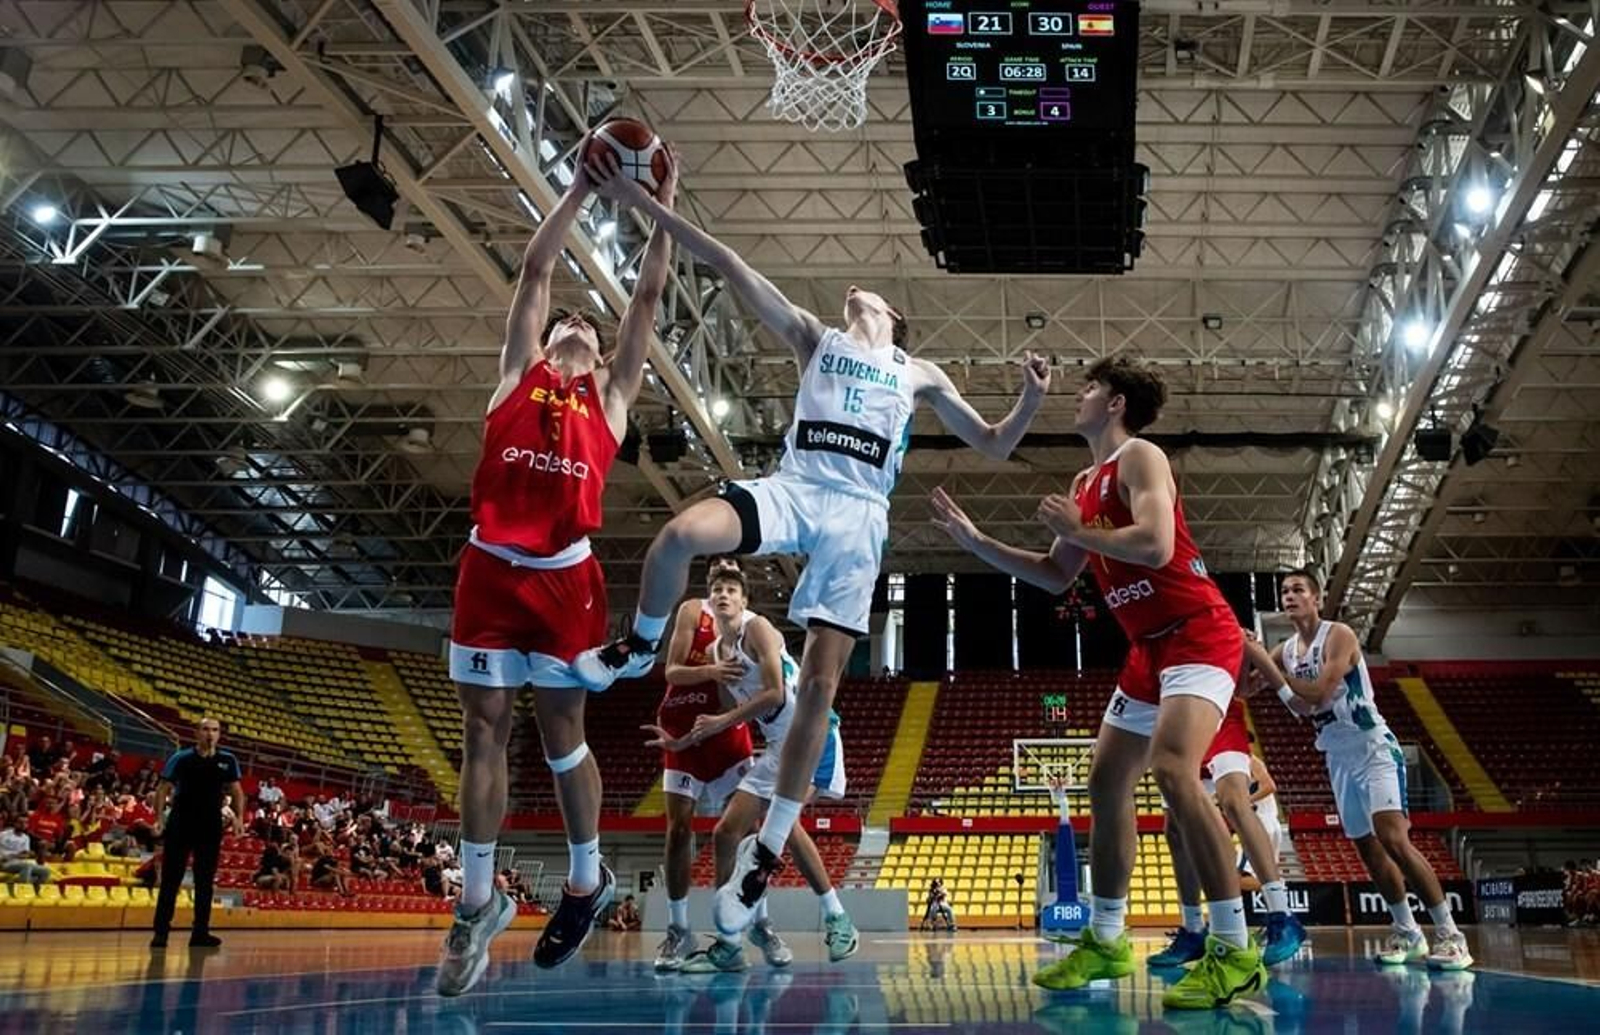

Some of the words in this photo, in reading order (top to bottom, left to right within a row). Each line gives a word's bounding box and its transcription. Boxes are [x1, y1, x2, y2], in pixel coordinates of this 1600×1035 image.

[925, 1, 951, 9] HOME
[978, 15, 1001, 32] 21
[1037, 16, 1063, 32] 30
[952, 66, 972, 78] 2Q
[1003, 66, 1043, 78] 06:28
[1072, 67, 1089, 79] 14
[986, 105, 996, 116] 3
[1050, 106, 1060, 117] 4
[820, 353, 898, 390] SLOVENIJA
[843, 387, 866, 413] 15
[807, 427, 881, 460] telemach
[502, 446, 590, 480] endesa
[1052, 706, 1067, 722] 14
[1252, 890, 1309, 909] KILI
[1053, 905, 1082, 921] FIBA
